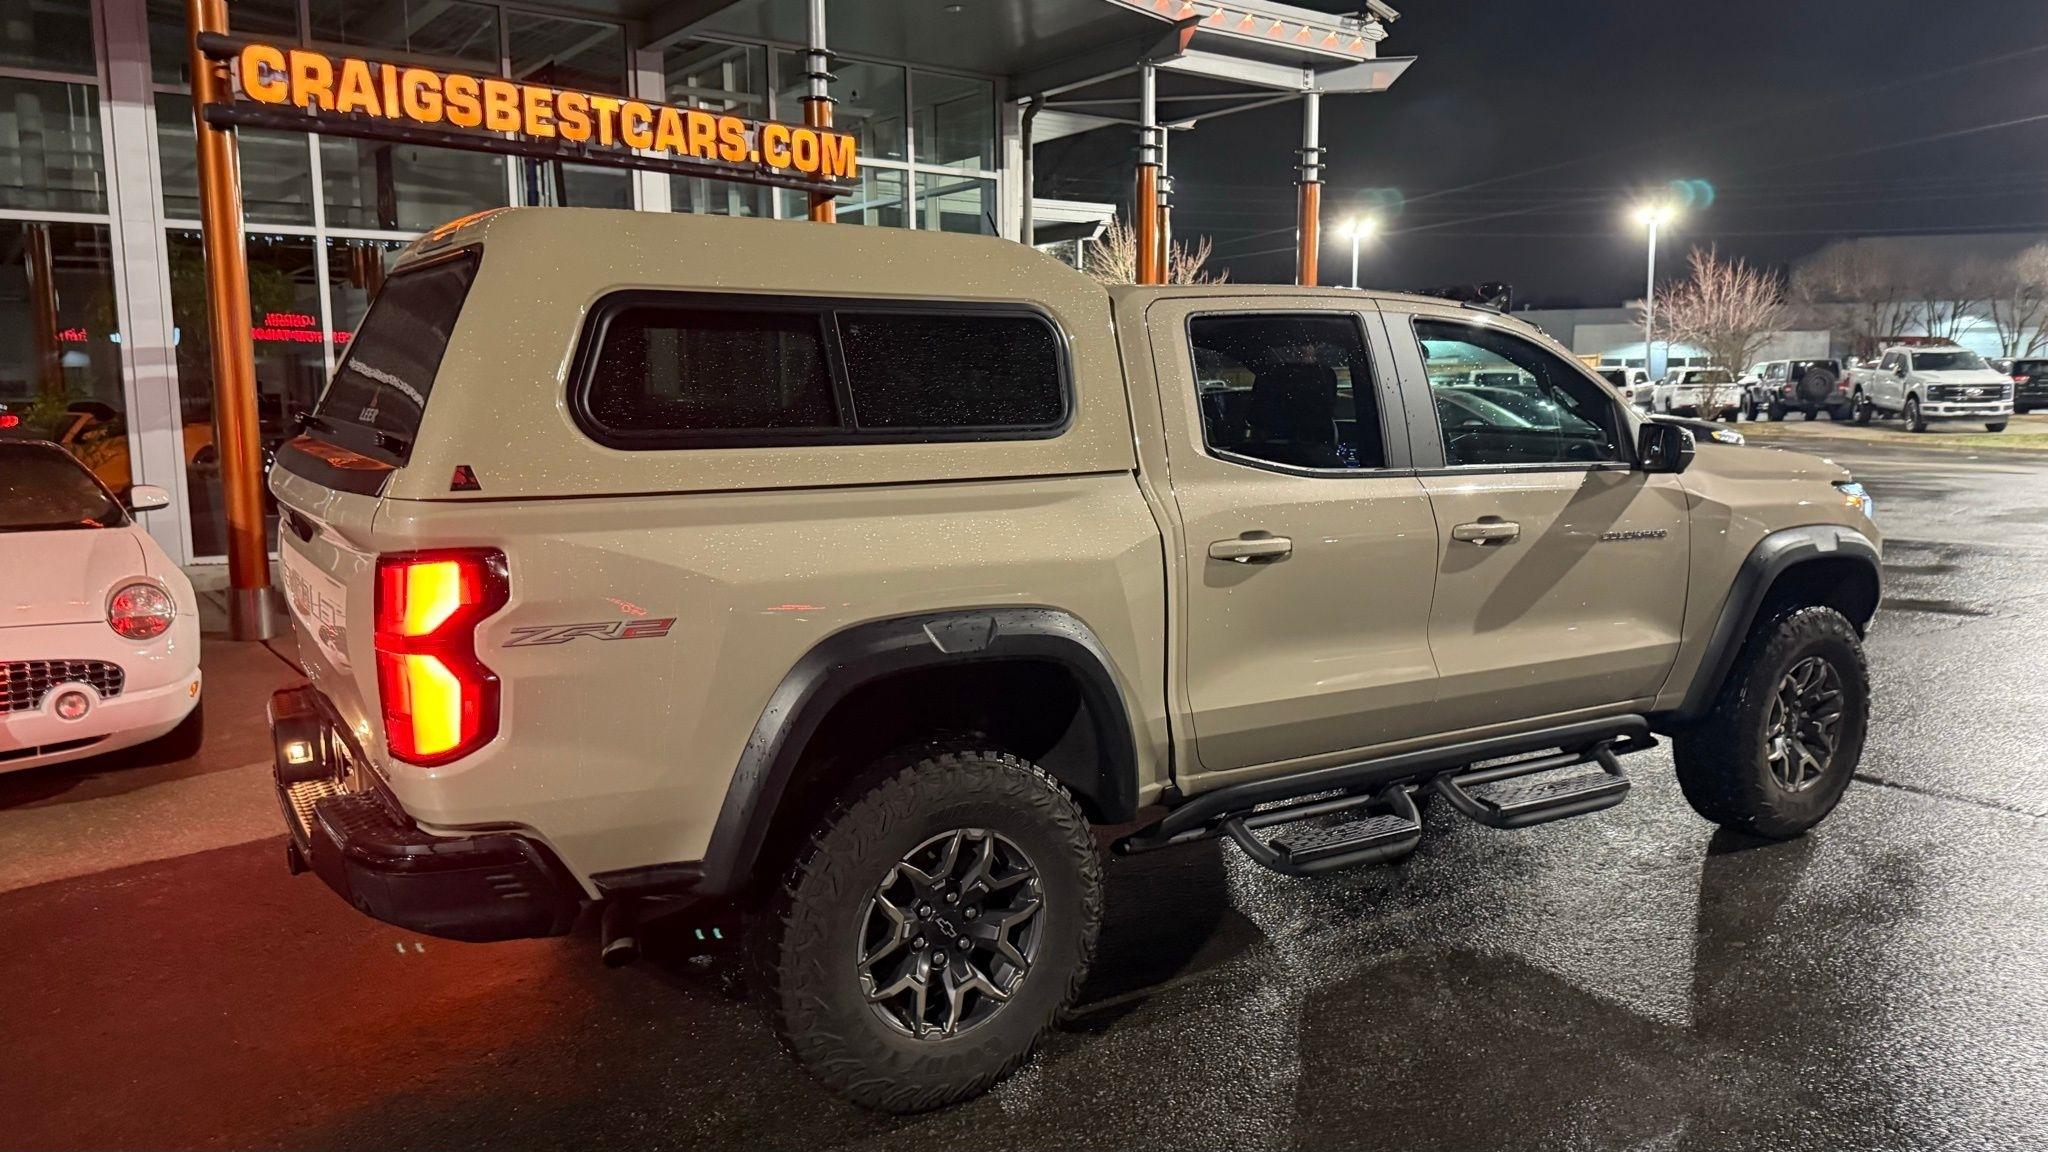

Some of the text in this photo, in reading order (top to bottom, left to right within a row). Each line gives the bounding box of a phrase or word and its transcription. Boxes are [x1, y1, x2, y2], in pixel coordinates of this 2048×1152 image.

[240, 44, 857, 178] CRAIGSBESTCARS.COM
[359, 407, 379, 423] LEER
[1600, 530, 1667, 541] COLORADO
[501, 617, 677, 647] ZR2
